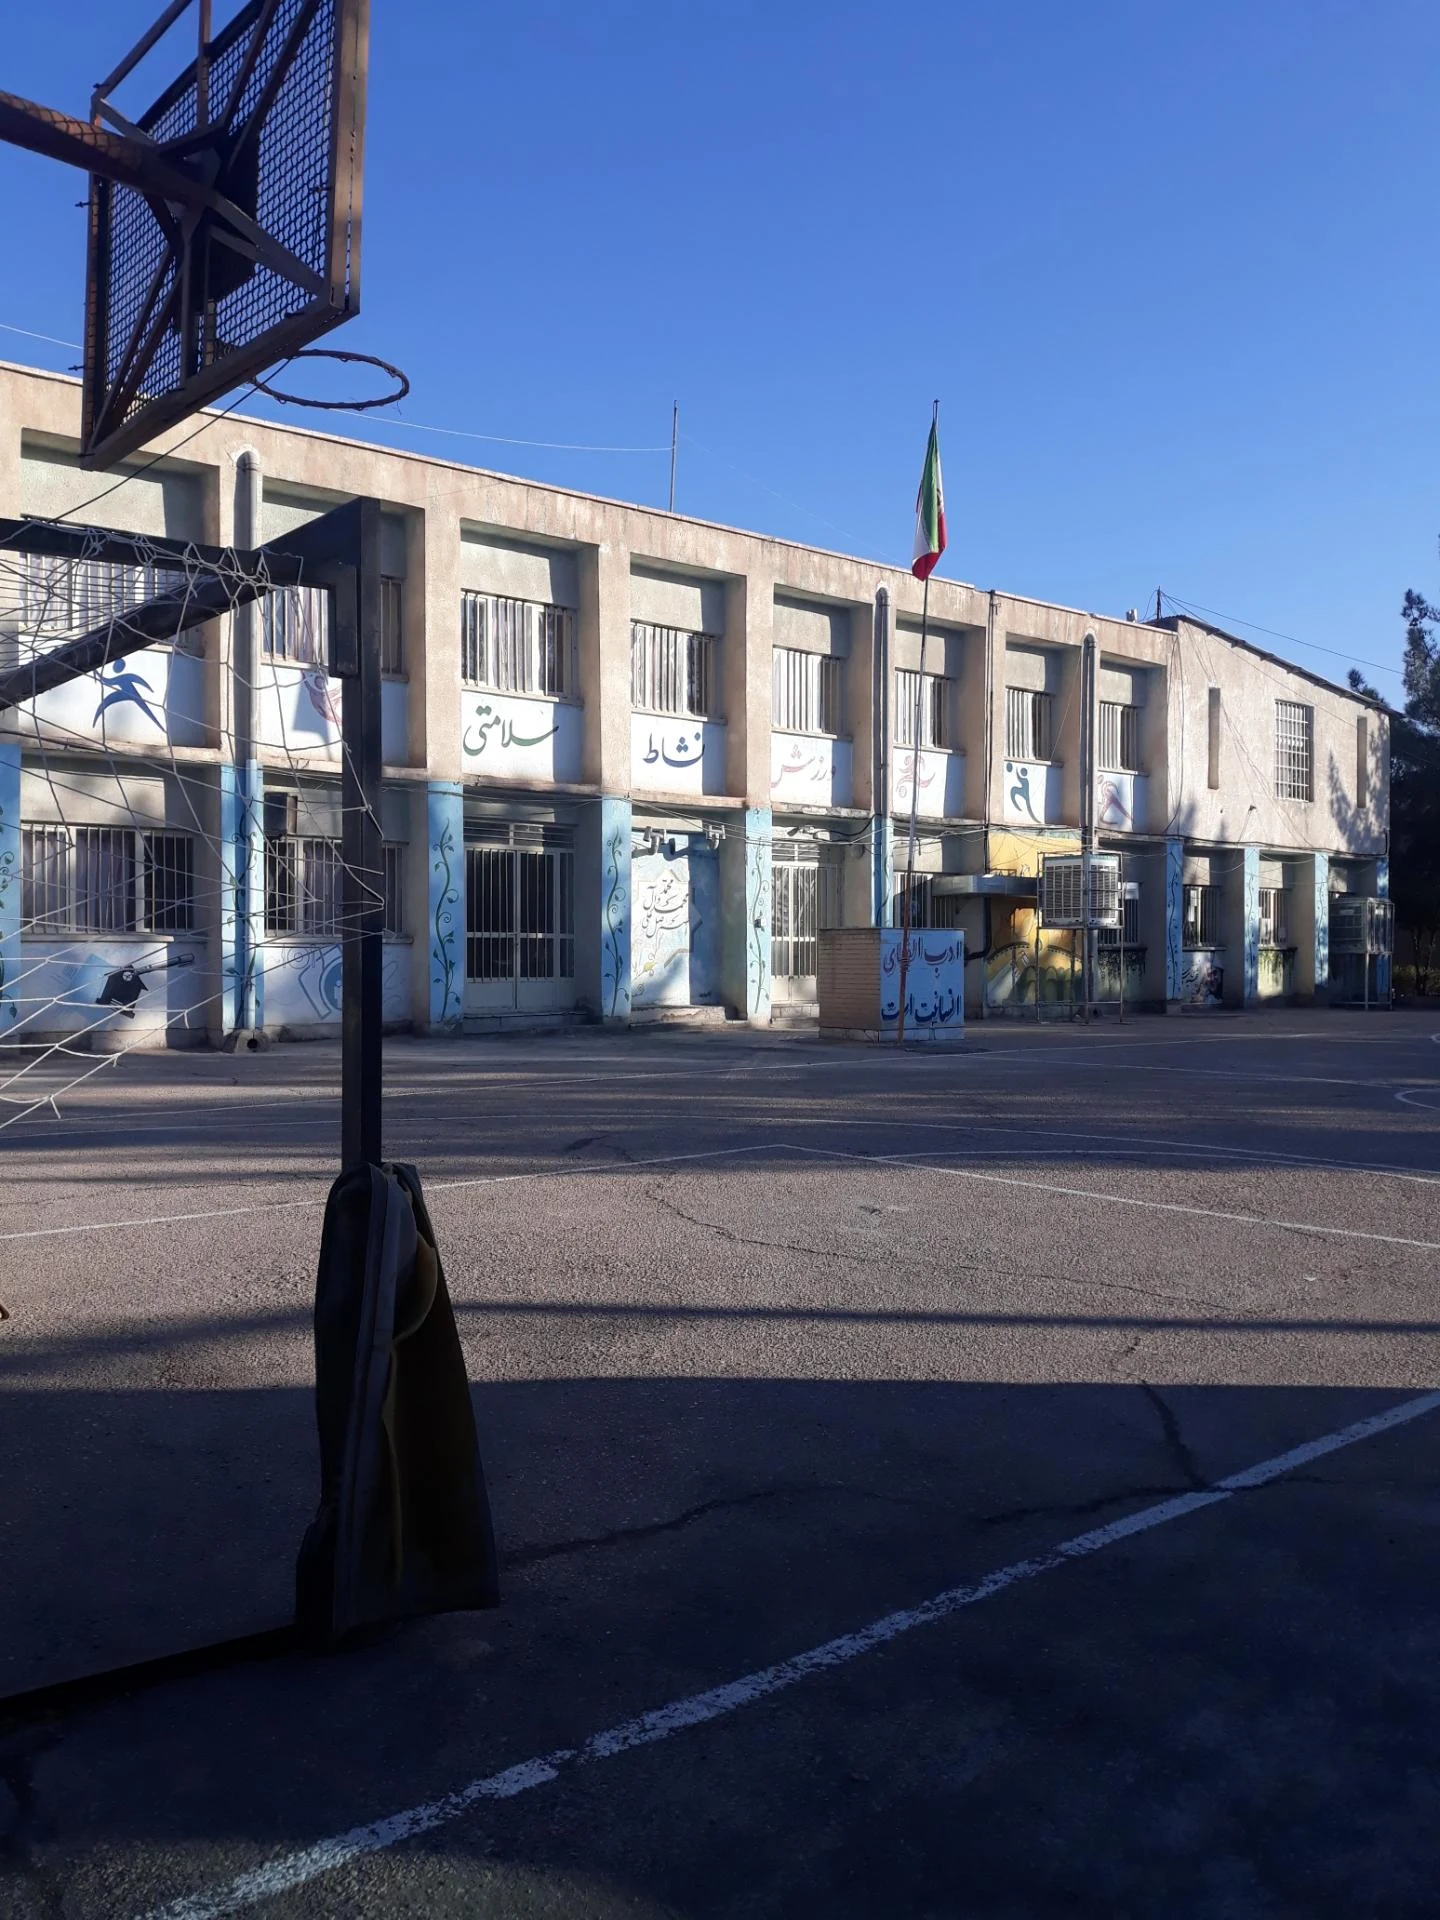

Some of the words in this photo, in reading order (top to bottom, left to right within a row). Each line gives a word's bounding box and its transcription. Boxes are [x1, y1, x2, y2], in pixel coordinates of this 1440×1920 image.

[463, 705, 559, 756] سلامتی
[643, 732, 705, 768] نشاط
[770, 744, 837, 788] ورزش
[924, 939, 961, 976] ادب
[914, 988, 961, 1025] انسانیت
